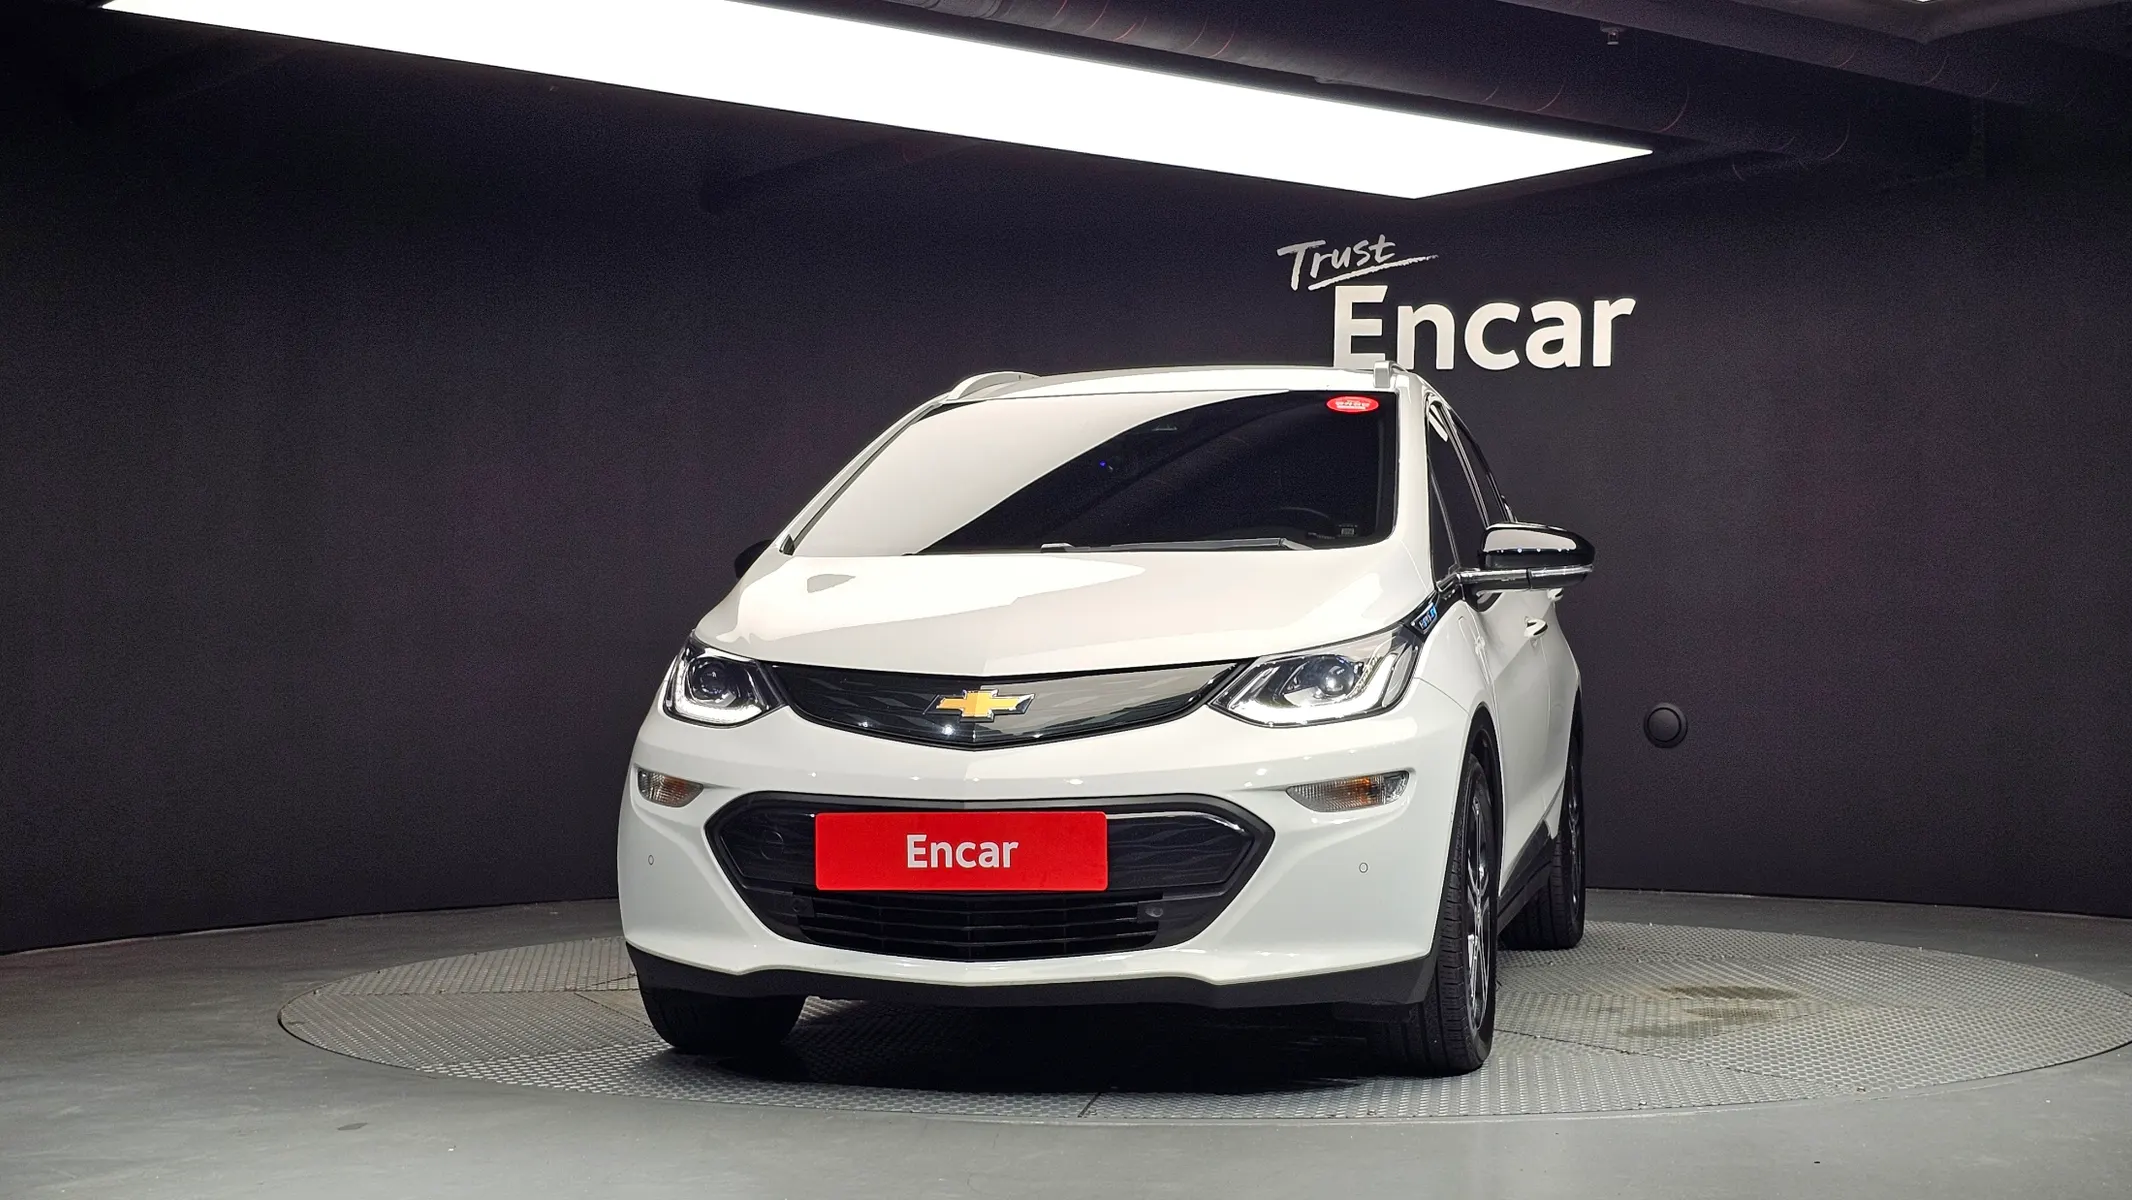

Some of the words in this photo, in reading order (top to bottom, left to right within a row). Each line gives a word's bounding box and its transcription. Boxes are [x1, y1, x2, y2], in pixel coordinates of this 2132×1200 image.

[1277, 234, 1396, 291] Trust
[1333, 285, 1637, 370] Encar
[906, 834, 1019, 868] Encar
